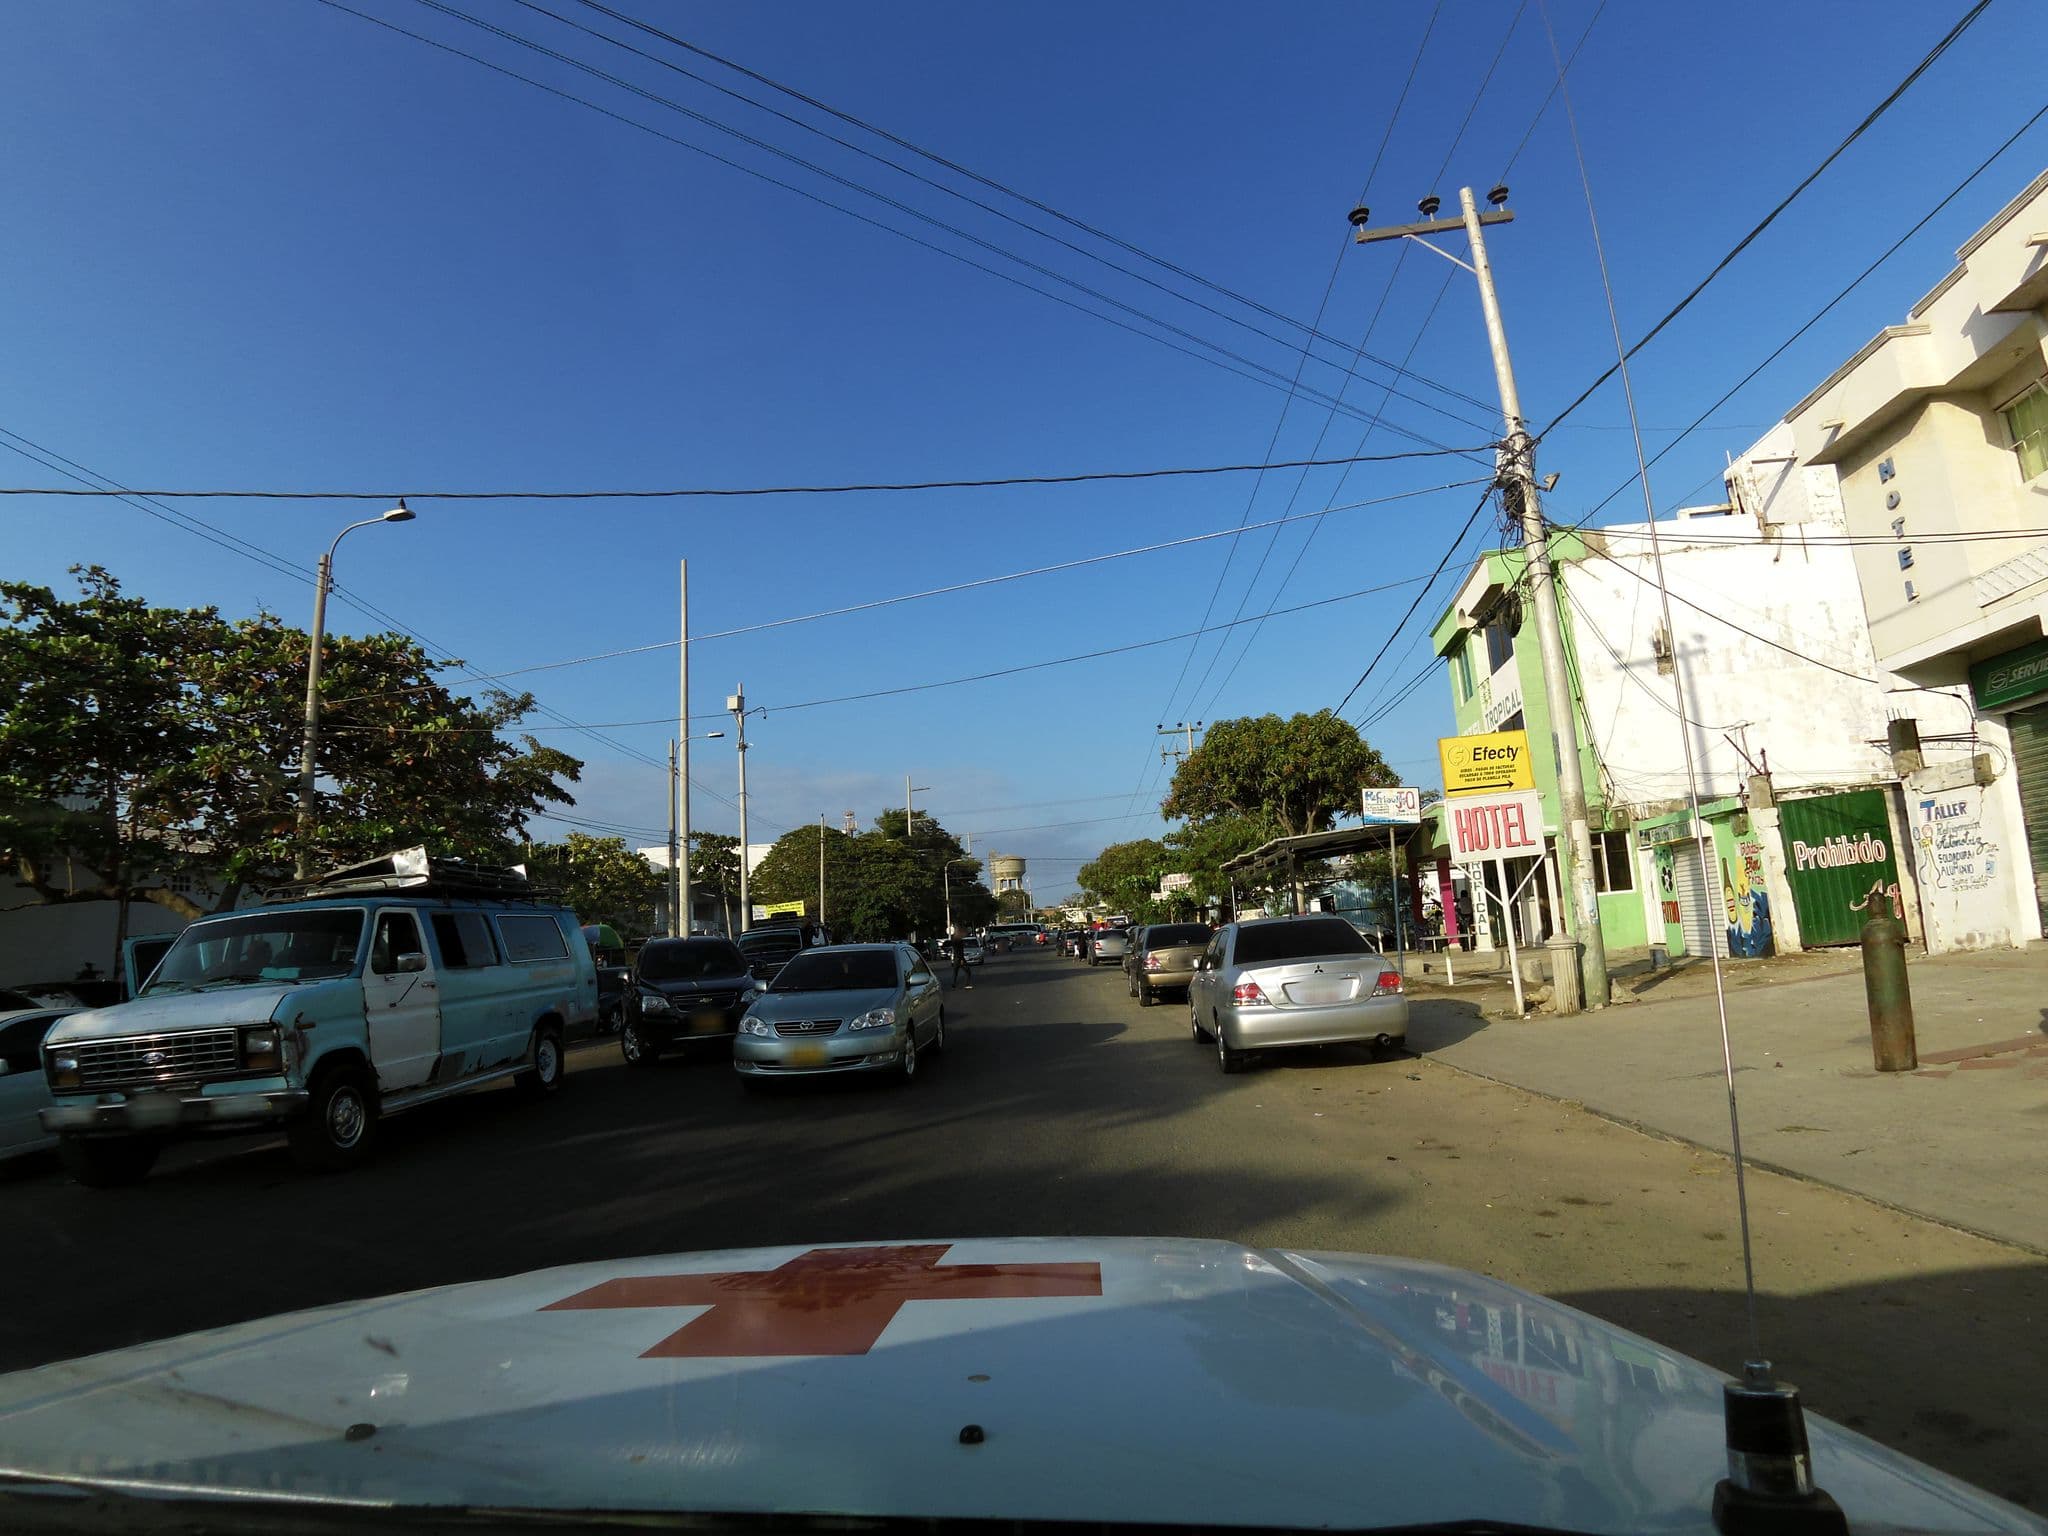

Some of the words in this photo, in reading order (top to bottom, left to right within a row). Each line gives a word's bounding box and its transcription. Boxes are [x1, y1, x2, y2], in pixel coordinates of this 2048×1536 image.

[1878, 457, 1920, 602] HOTEL
[1485, 688, 1522, 731] TROPICAL
[1472, 745, 1519, 761] Efecty
[1454, 802, 1536, 853] HOTEL
[1920, 799, 1967, 821] TALLER
[1793, 832, 1887, 871] Prohibido
[1471, 862, 1489, 935] ROPICAL
